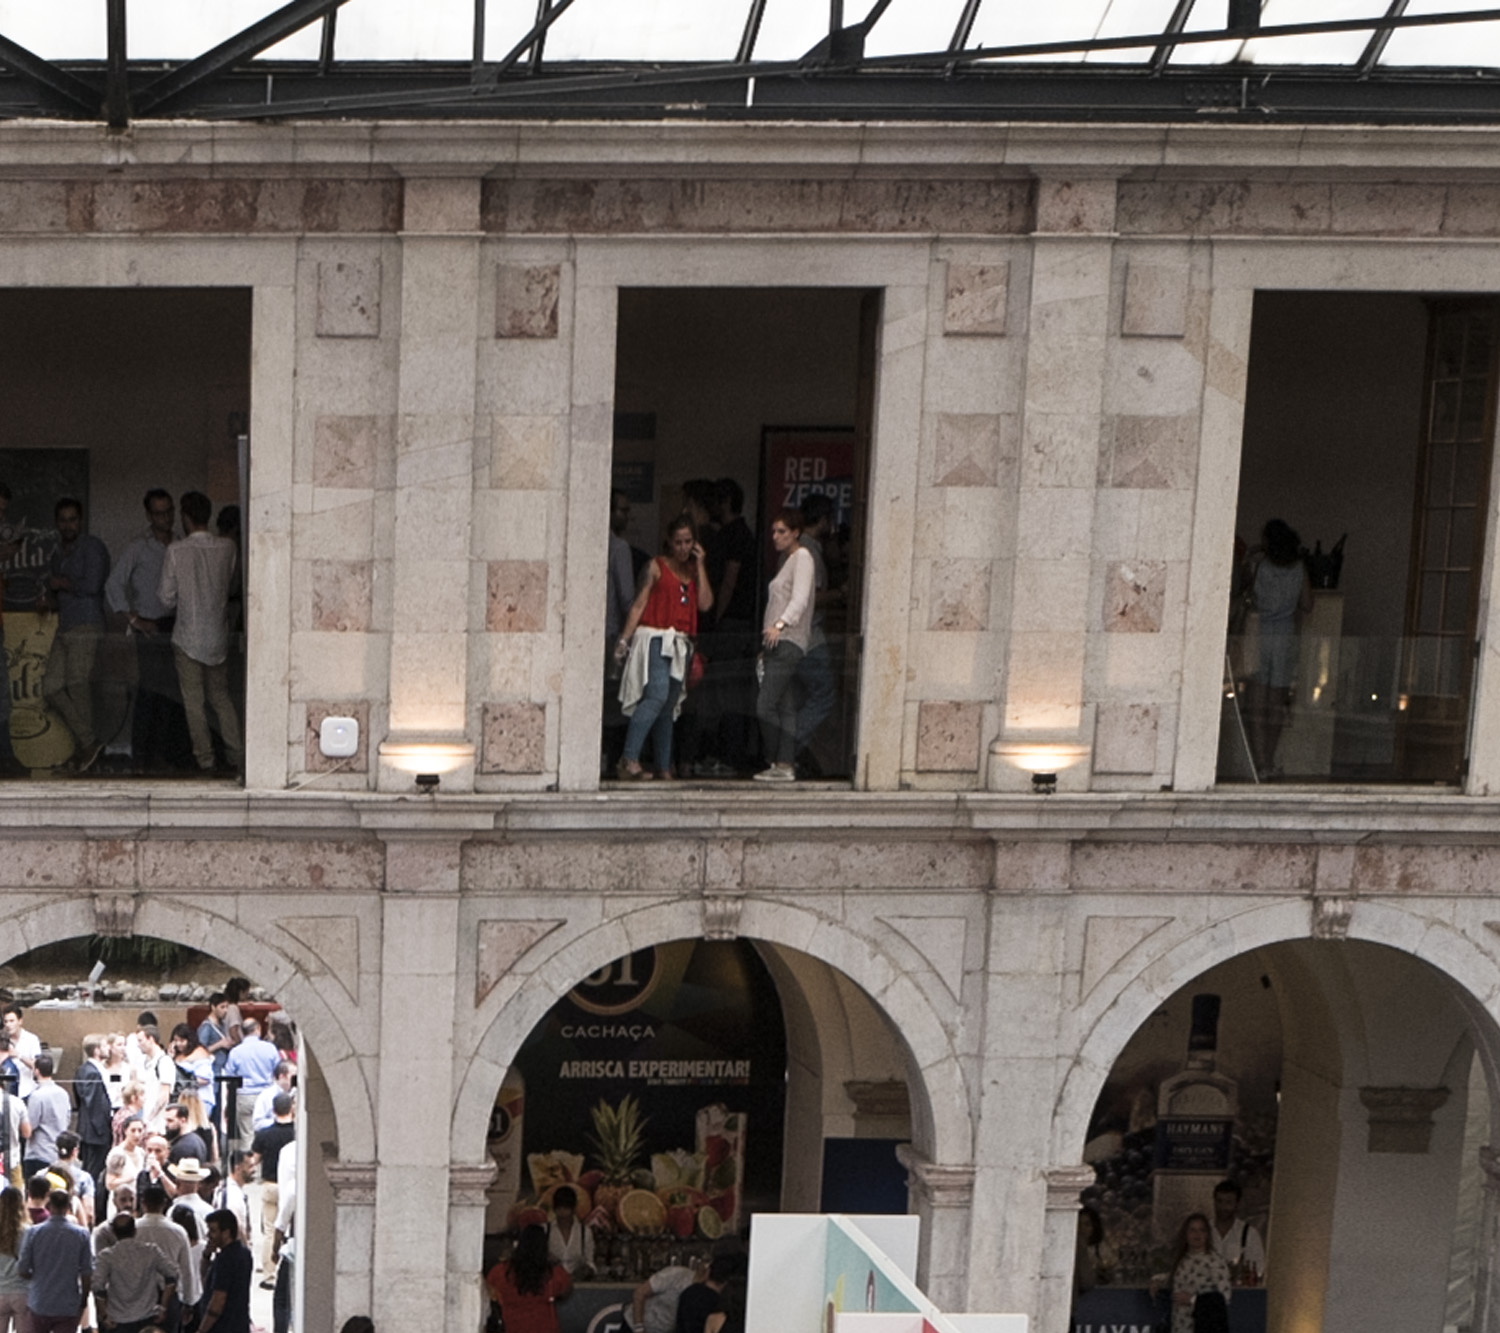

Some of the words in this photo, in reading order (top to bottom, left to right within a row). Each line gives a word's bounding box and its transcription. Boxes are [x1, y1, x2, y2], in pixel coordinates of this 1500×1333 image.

[784, 457, 827, 482] RED
[561, 1025, 656, 1040] CACHAÇA
[559, 1060, 624, 1078] ARRISCA
[629, 1060, 751, 1078] EXPERIMENTAR!
